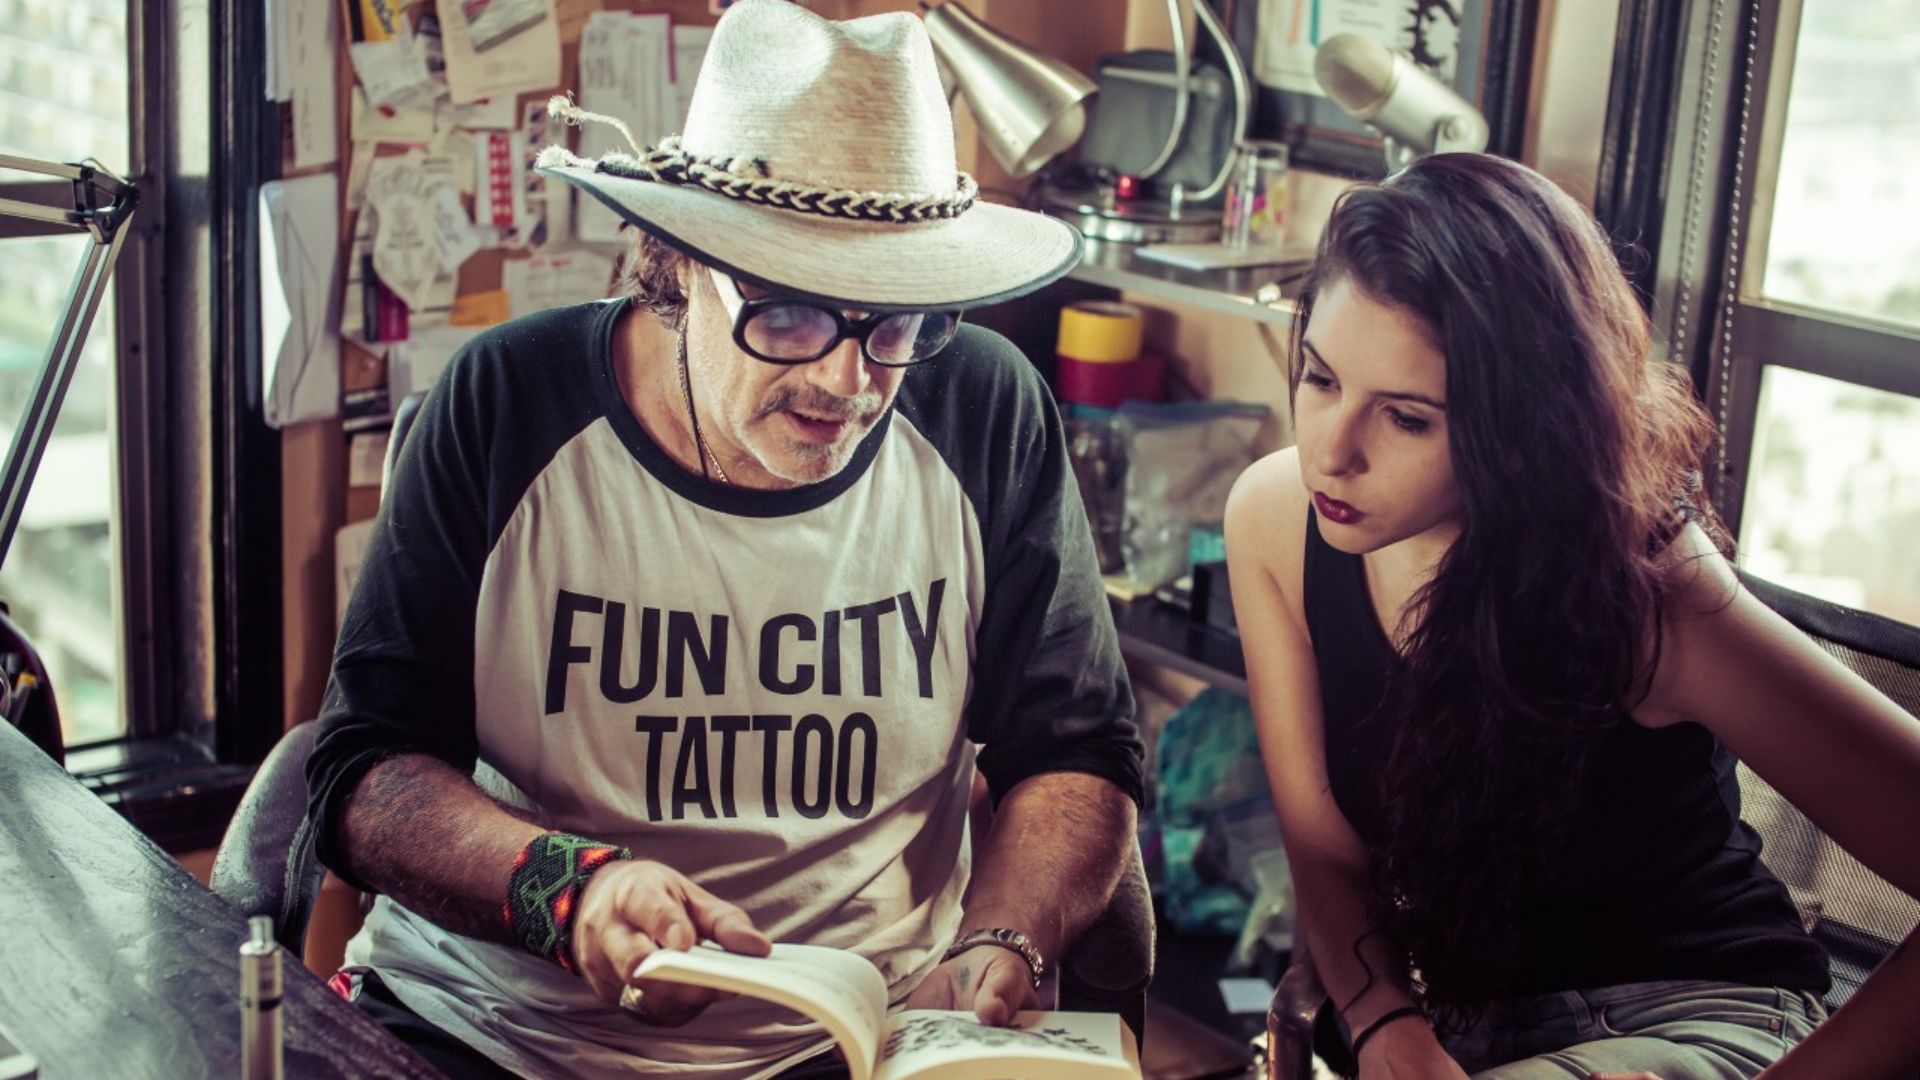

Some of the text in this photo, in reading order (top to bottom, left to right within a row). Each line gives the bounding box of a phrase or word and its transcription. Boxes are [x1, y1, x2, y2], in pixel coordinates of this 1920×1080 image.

[545, 578, 946, 716] FUN CITY
[635, 711, 878, 821] TATTOO
